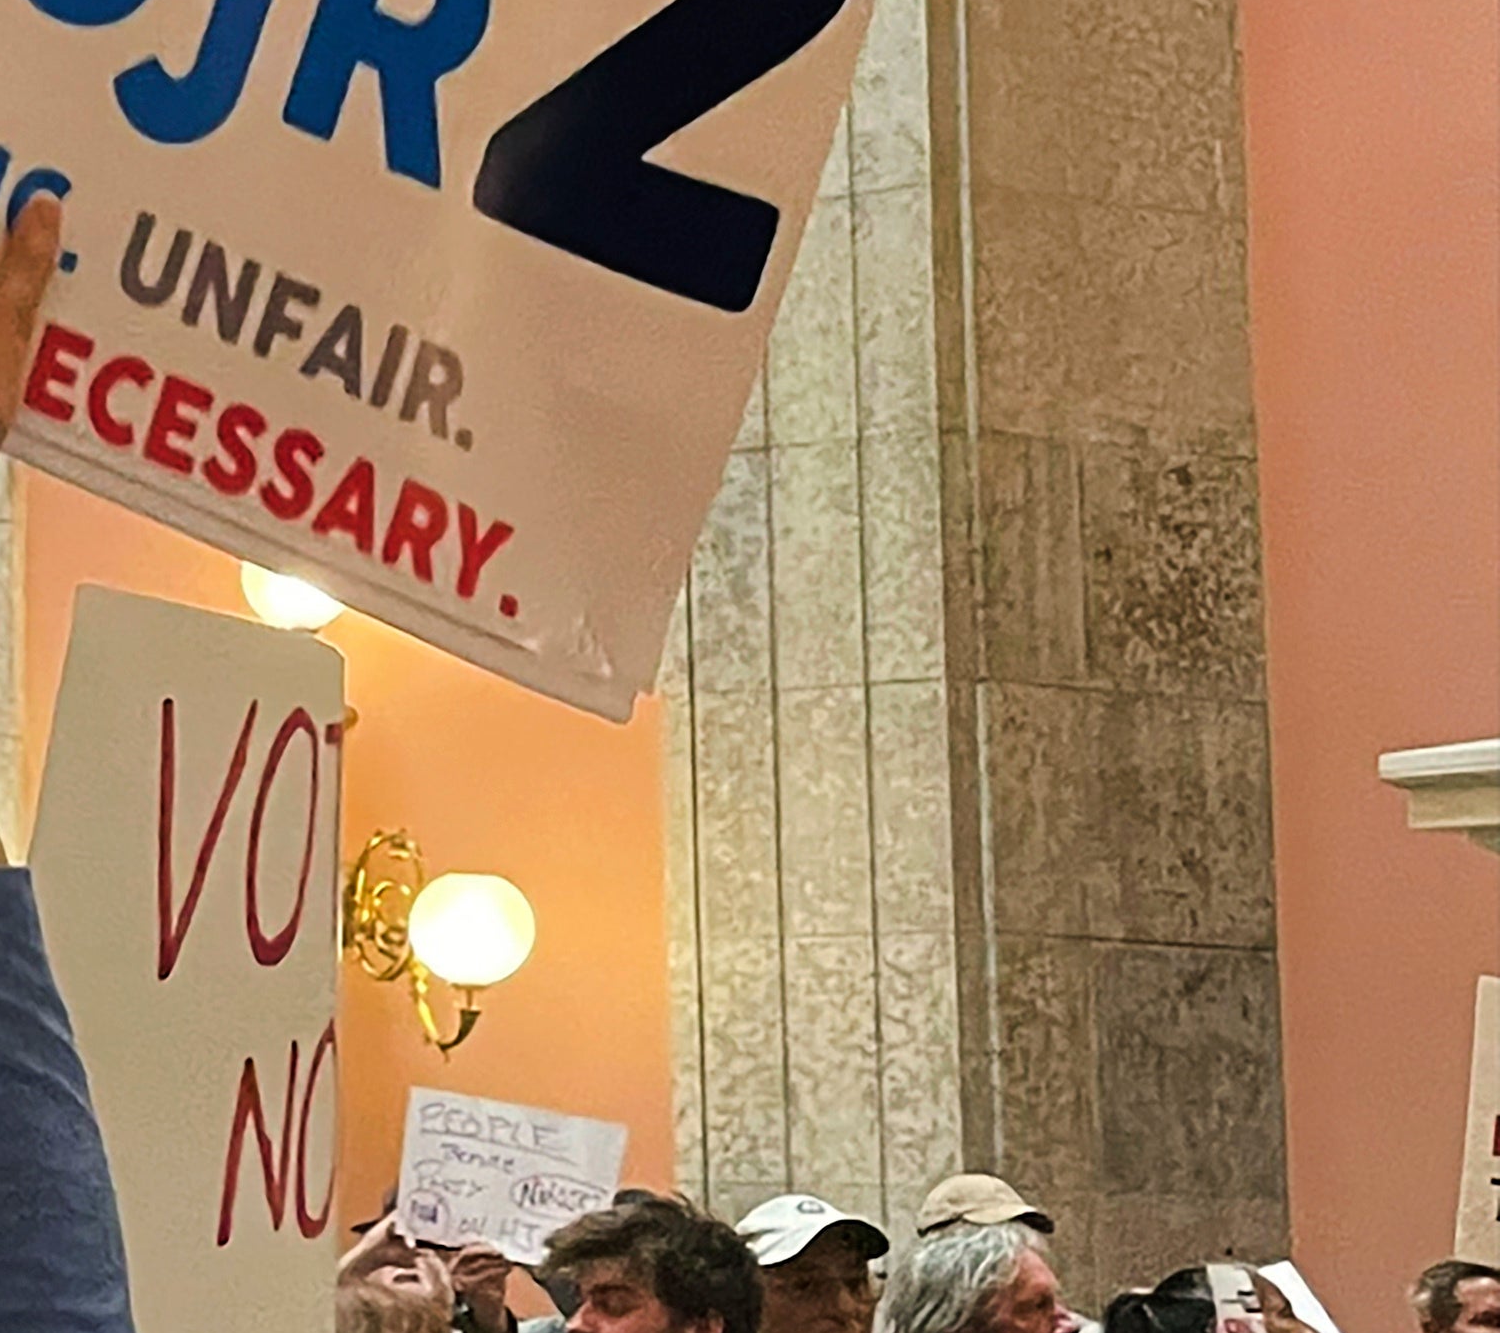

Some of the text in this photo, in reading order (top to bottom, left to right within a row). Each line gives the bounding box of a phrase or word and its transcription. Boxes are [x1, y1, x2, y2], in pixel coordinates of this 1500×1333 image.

[118, 208, 473, 448] UNFAIR.
[22, 322, 520, 617] ECESSARY.
[157, 697, 343, 981] VO
[216, 1017, 336, 1249] NO
